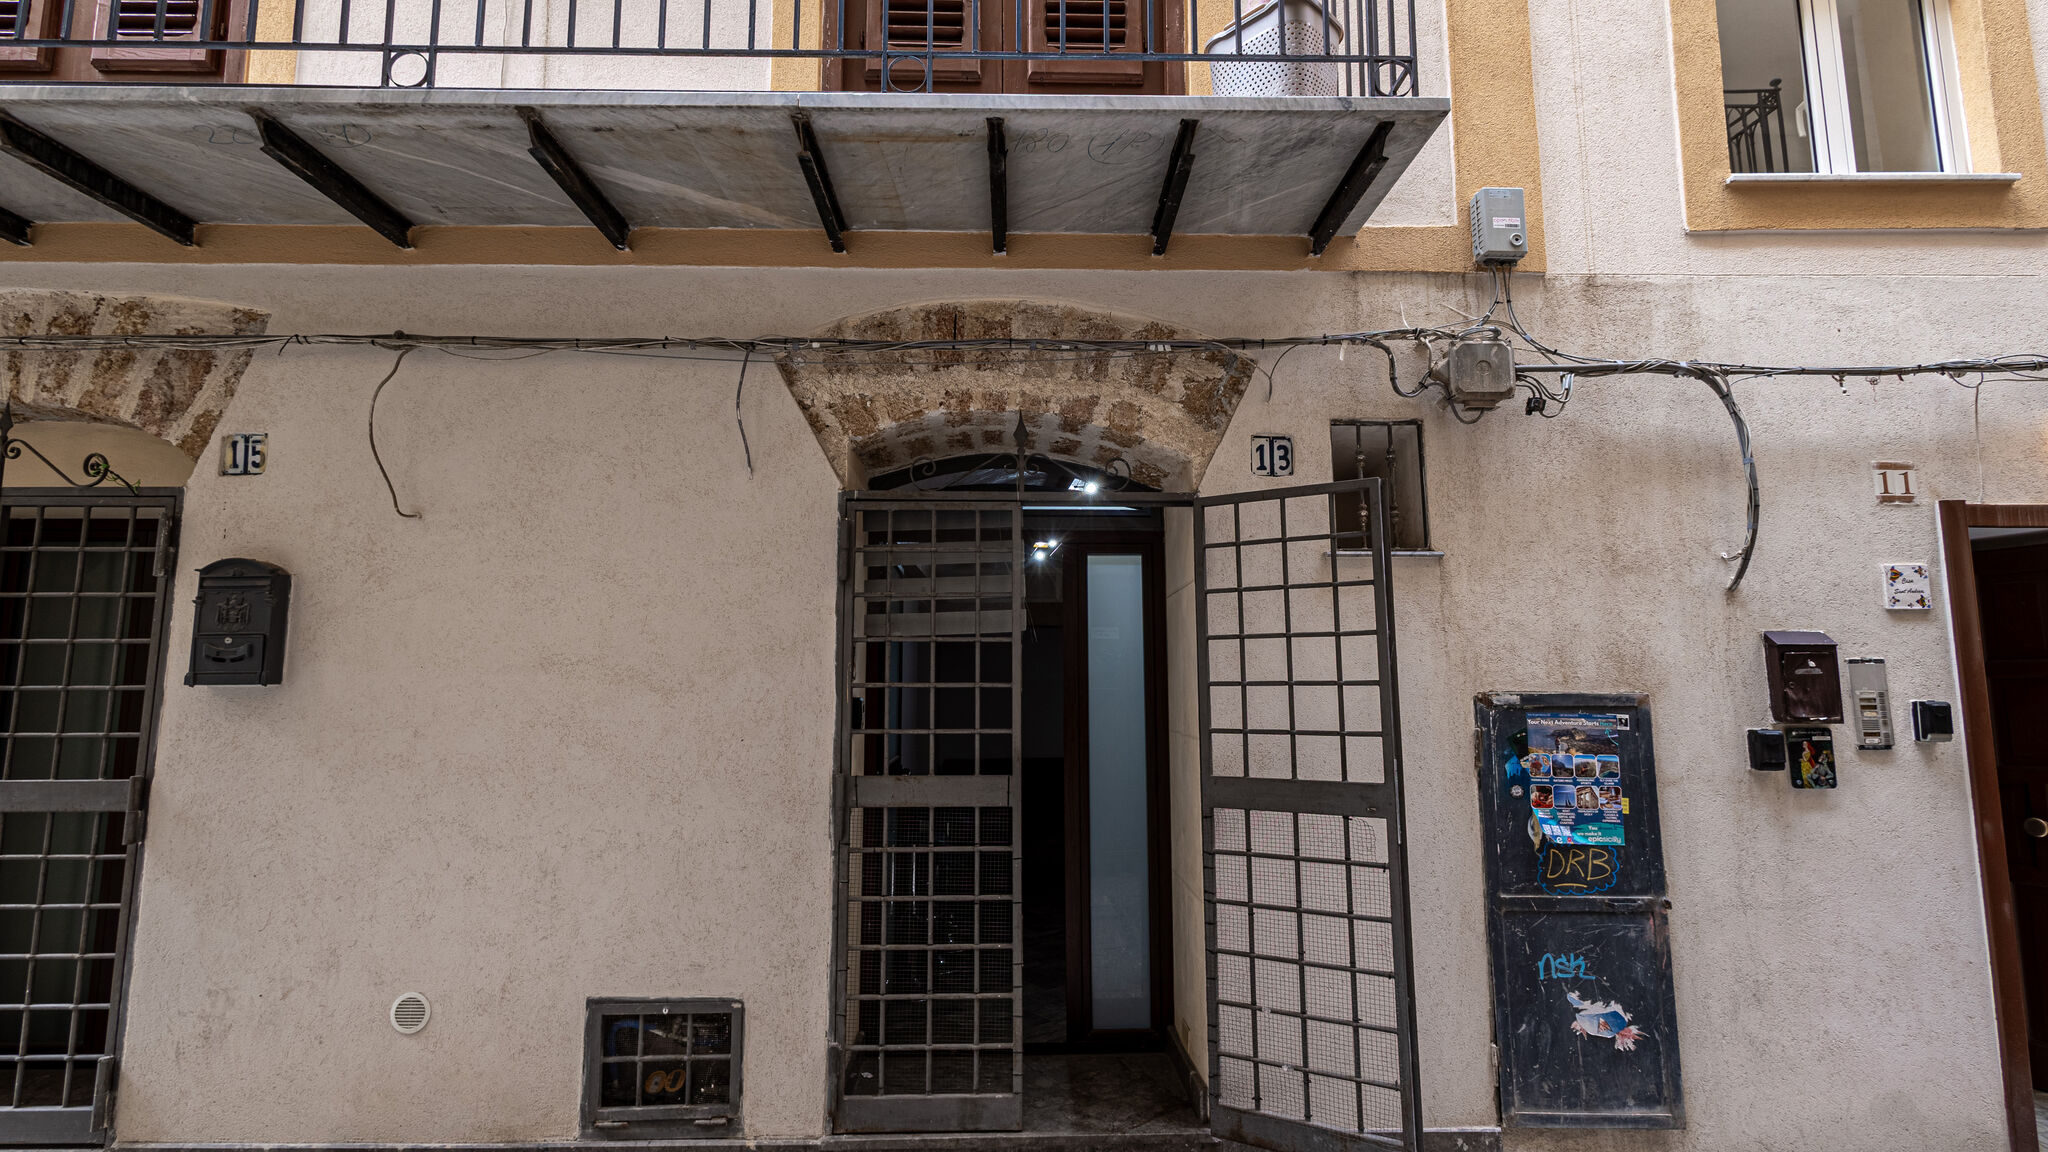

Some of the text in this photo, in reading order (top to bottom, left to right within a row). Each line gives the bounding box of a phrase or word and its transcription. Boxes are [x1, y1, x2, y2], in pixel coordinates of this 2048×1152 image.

[229, 440, 266, 469] 15
[1255, 444, 1291, 471] 13
[1877, 471, 1915, 495] 11
[1554, 719, 1582, 727] Adventure
[1547, 848, 1611, 881] DRB
